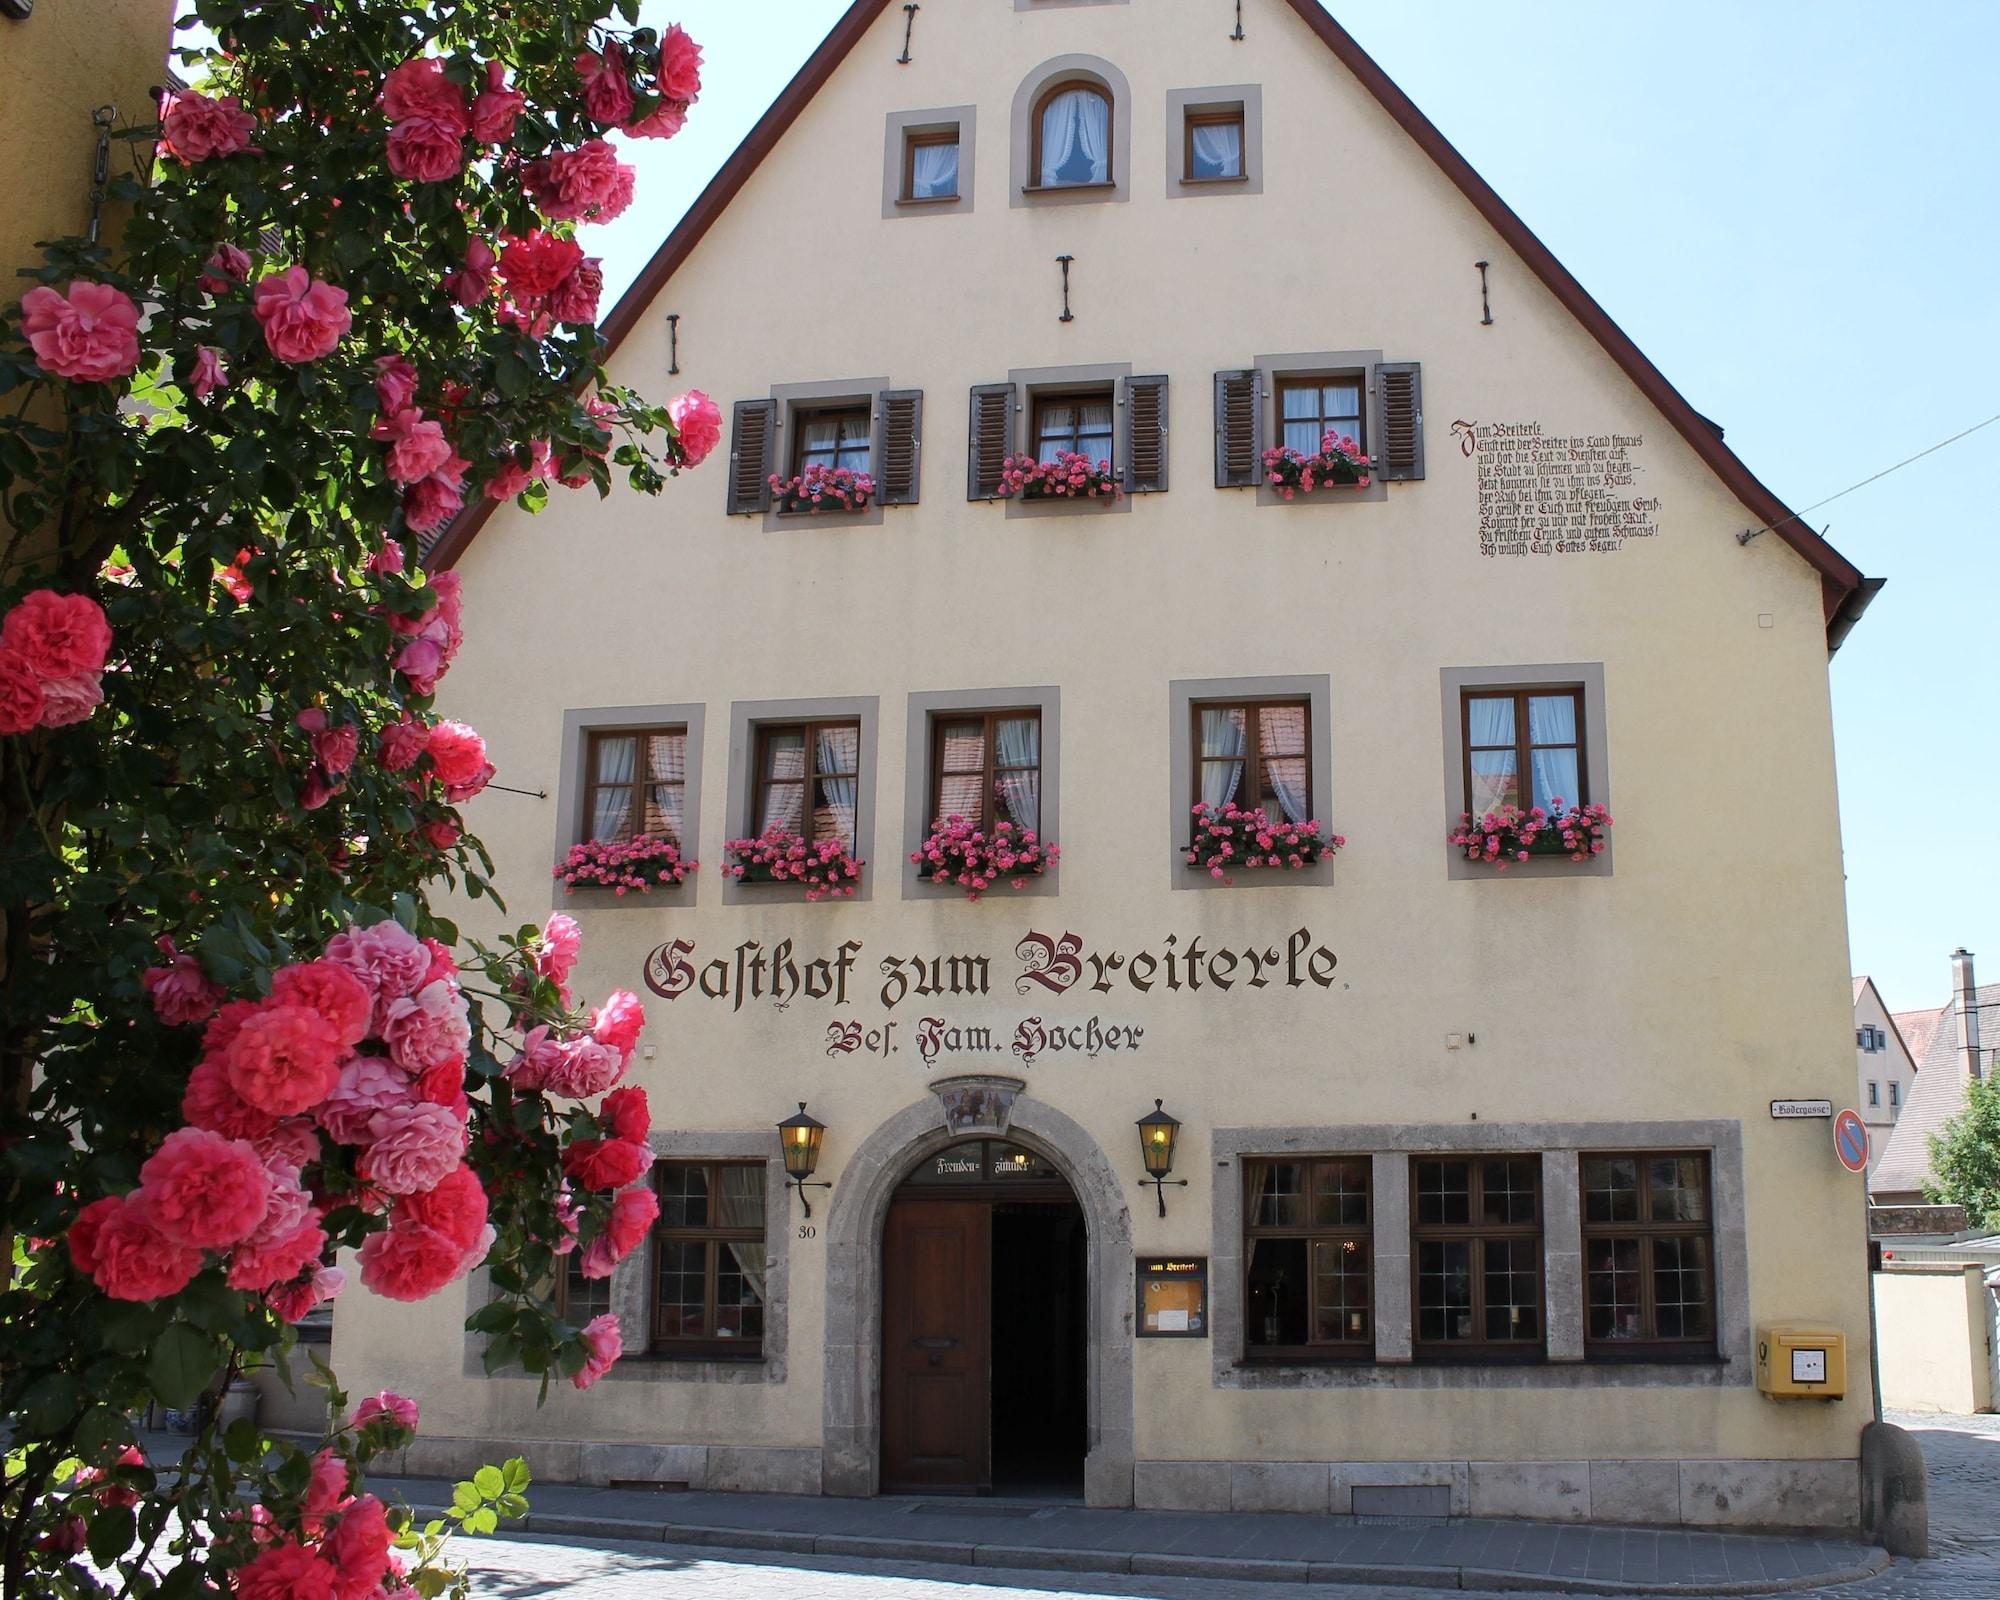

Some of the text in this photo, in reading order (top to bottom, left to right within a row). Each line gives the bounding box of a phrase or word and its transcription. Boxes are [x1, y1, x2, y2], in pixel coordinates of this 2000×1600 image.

[1449, 419, 1491, 458] Zum
[1517, 439, 1531, 450] der
[1531, 437, 1568, 449] Breiter
[1570, 436, 1584, 448] ins
[1587, 435, 1610, 448] Land
[1612, 434, 1643, 450] hinaus
[1478, 454, 1495, 464] und
[1516, 452, 1529, 463] die
[1478, 465, 1491, 477] die
[1493, 464, 1521, 477] Stadt
[1523, 465, 1534, 476] zu
[1575, 462, 1591, 474] und
[1593, 462, 1605, 473] zu
[1500, 478, 1538, 490] kommen
[1553, 477, 1565, 488] zu
[1586, 475, 1601, 487] ins
[1478, 491, 1494, 504] der
[1519, 489, 1532, 502] bei
[1554, 490, 1567, 500] zu
[1479, 503, 1494, 516] So
[1524, 504, 1535, 515] er
[1538, 502, 1564, 515] Euch
[1566, 501, 1582, 513] mit
[1480, 516, 1518, 530] Kommt
[1538, 517, 1550, 529] zu
[1551, 516, 1569, 527] mir
[1571, 514, 1587, 526] mit
[1479, 530, 1493, 543] Zu
[1533, 527, 1564, 540] Trunk
[1566, 527, 1582, 539] und
[1480, 543, 1497, 558] Ich
[1530, 540, 1553, 556] Euch
[1555, 540, 1586, 553] Gottes
[879, 952, 992, 1011] zum
[1015, 925, 1338, 997] Breiterle
[915, 1016, 1003, 1069] Fam.
[1011, 1015, 1145, 1069] Hocher
[798, 1225, 816, 1239] 30
